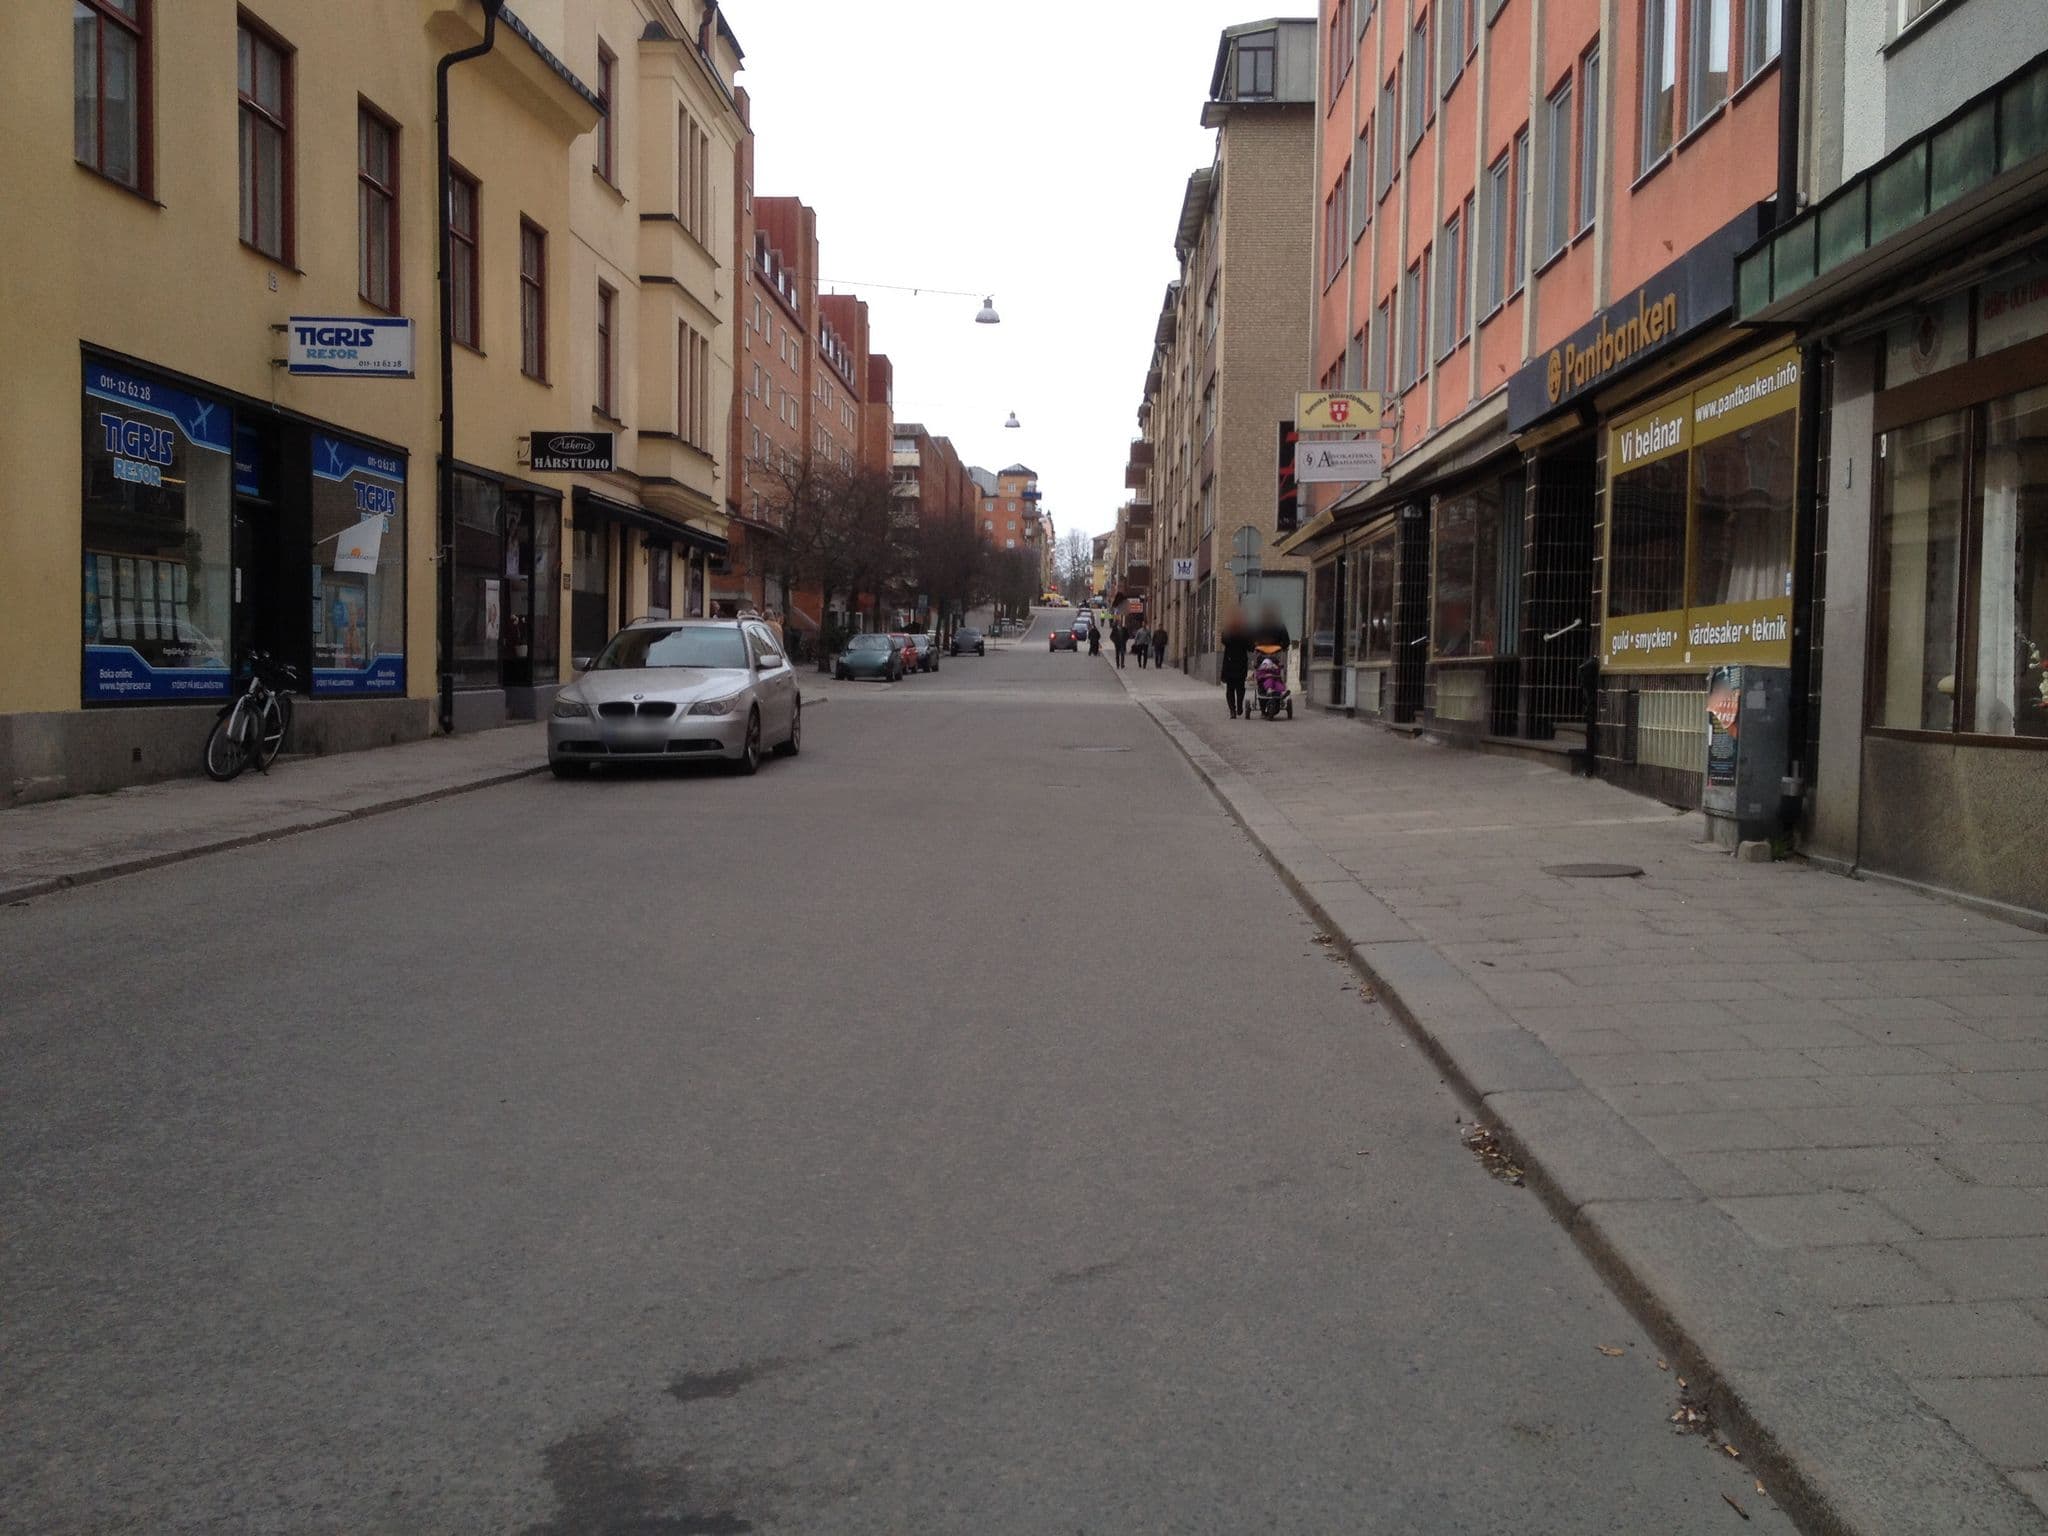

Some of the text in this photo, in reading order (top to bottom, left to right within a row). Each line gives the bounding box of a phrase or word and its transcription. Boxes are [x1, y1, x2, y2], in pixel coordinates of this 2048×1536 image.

[295, 327, 375, 347] TIGRIS
[1565, 289, 1677, 393] Pantbanken
[306, 348, 358, 359] RESOR
[128, 381, 139, 397] 62
[140, 386, 152, 401] 28
[1695, 361, 1797, 422] www.pantbanken.info
[100, 412, 174, 466] TIGRIS
[1621, 416, 1683, 464] Vi belånar
[113, 457, 162, 487] RESOR
[535, 456, 609, 469] HÅRSTUDIO
[353, 480, 396, 516] TIGRIS
[1612, 627, 1672, 655] guld smycken
[1689, 614, 1786, 646] värdesaker teknik
